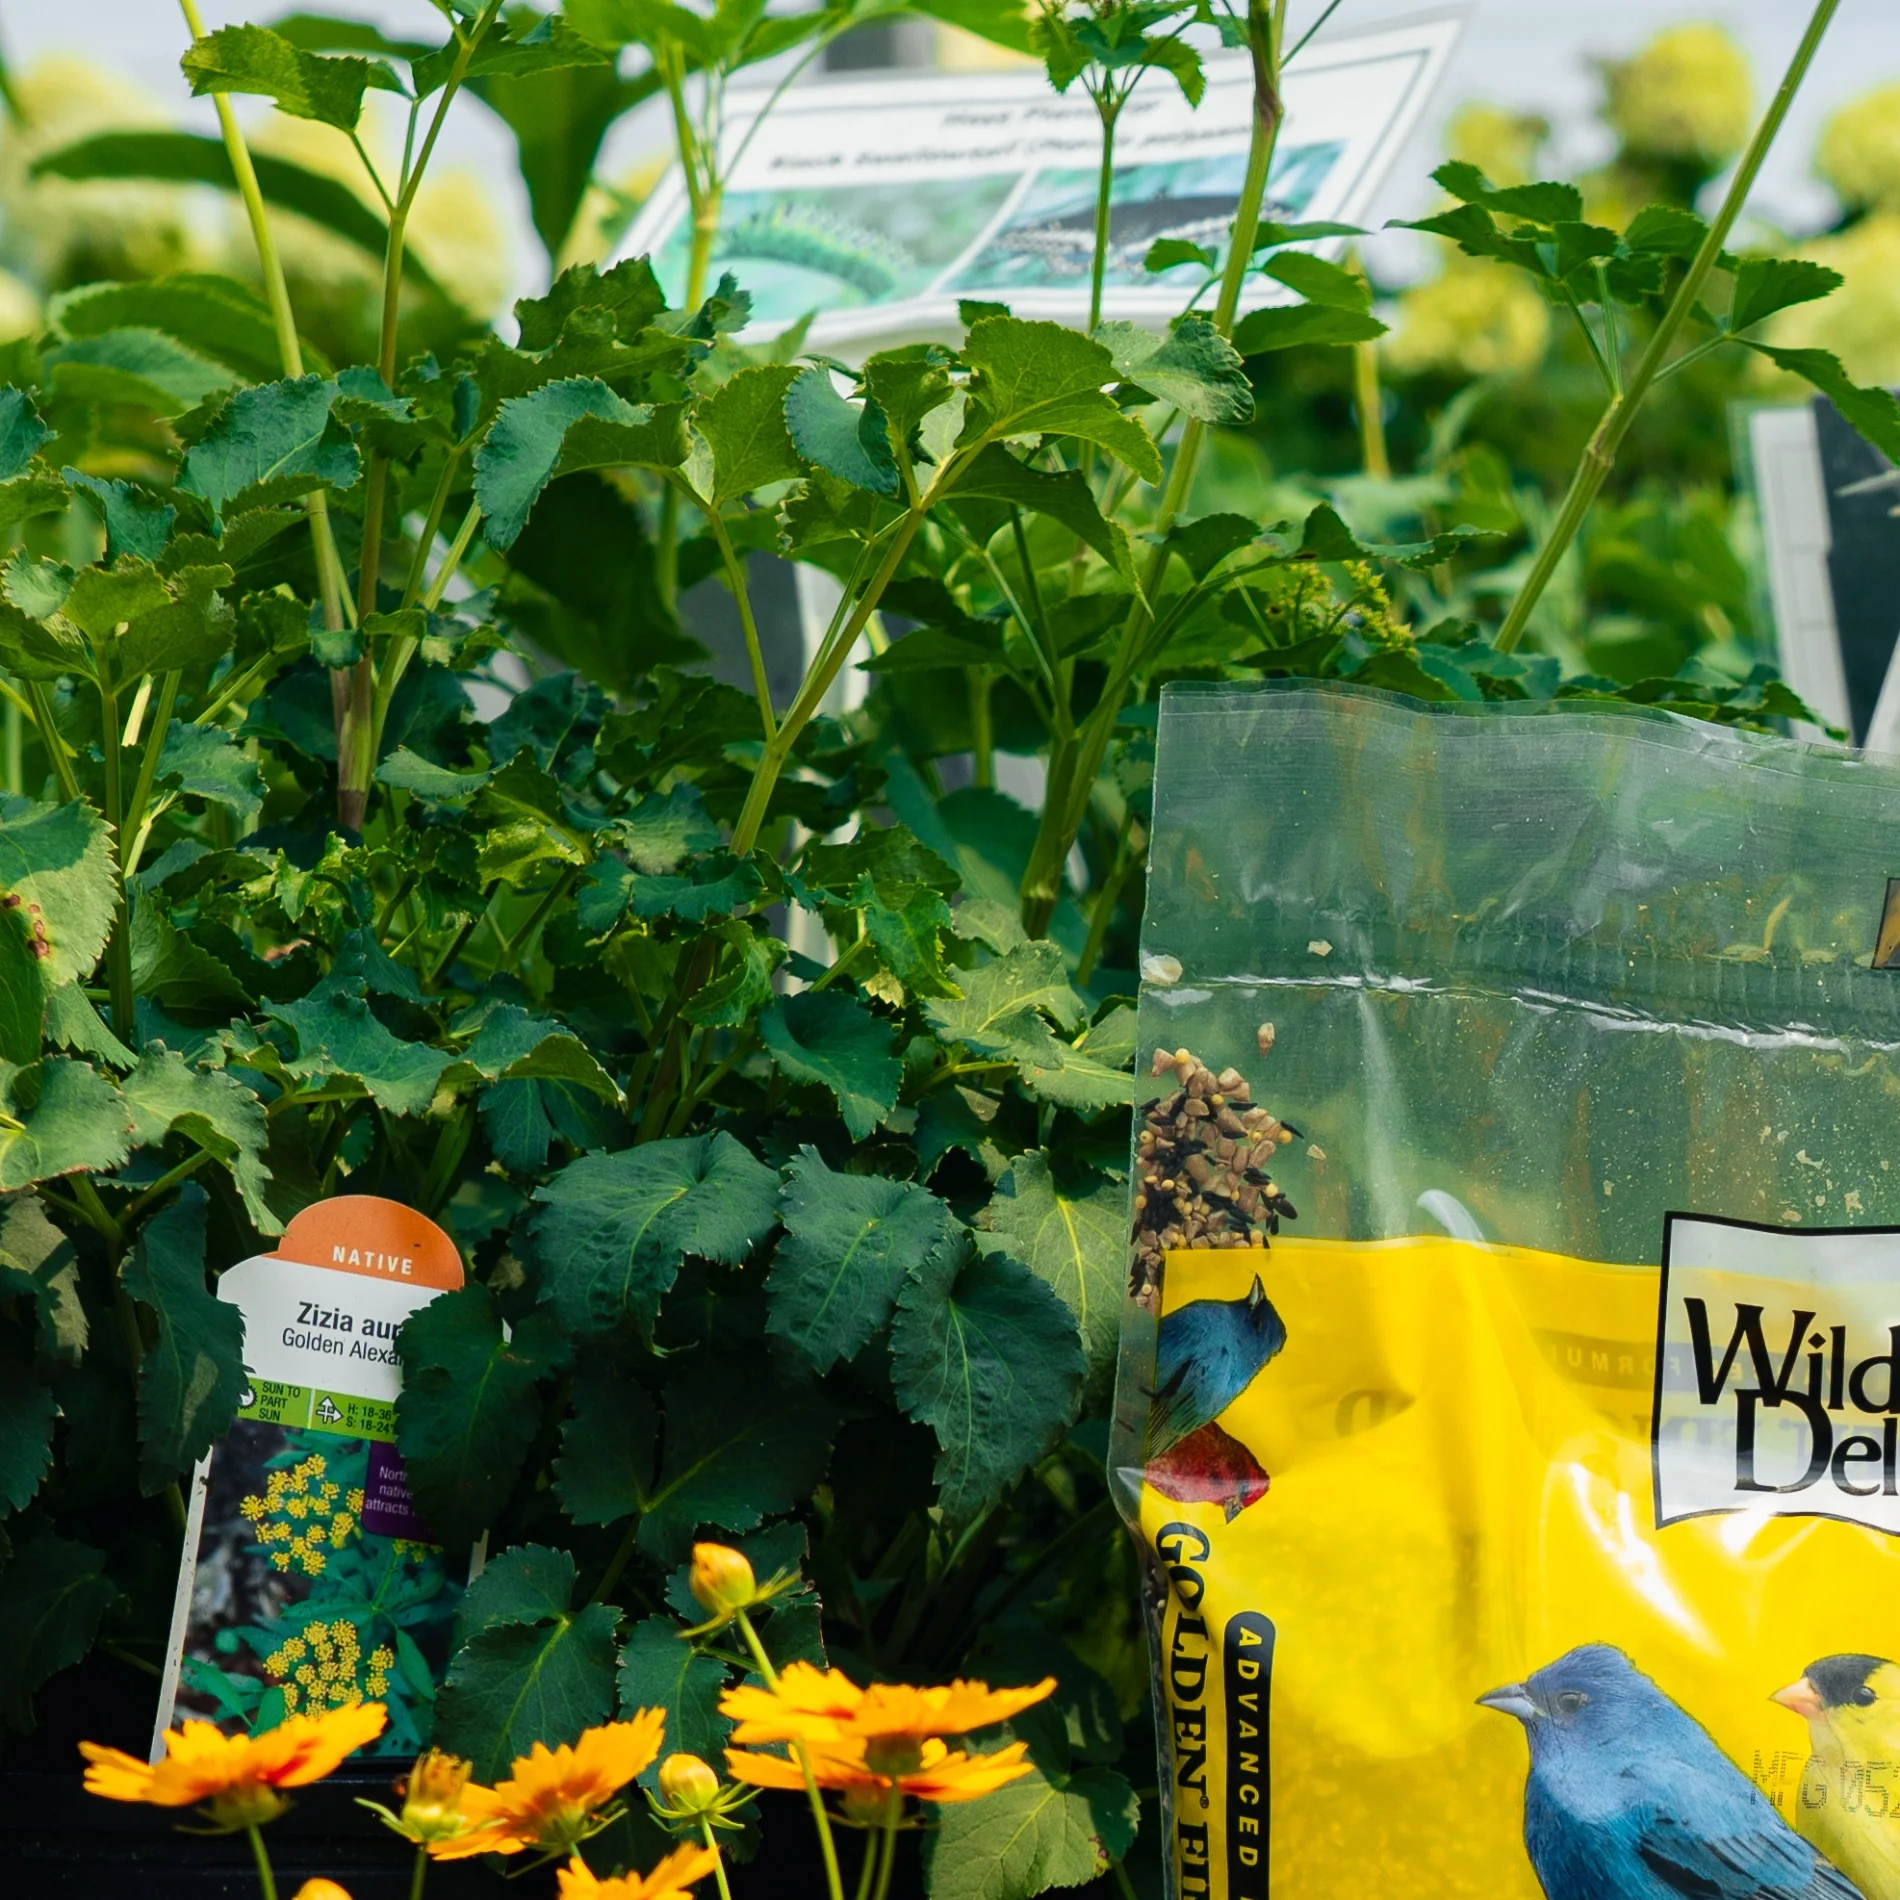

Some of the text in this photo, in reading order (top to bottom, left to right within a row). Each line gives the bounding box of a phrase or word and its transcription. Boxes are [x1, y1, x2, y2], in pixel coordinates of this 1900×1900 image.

[332, 1245, 413, 1276] NATIVE
[297, 1301, 402, 1341] Zizia aur
[282, 1327, 403, 1367] Golden Alexa
[262, 1381, 301, 1398] SUN TO
[259, 1395, 288, 1409] PART
[347, 1403, 358, 1415] H:
[258, 1407, 281, 1422] SUN
[345, 1416, 357, 1428] S:
[378, 1484, 414, 1500] native
[365, 1497, 410, 1516] attracts
[1238, 1627, 1263, 1868] ADVANCED
